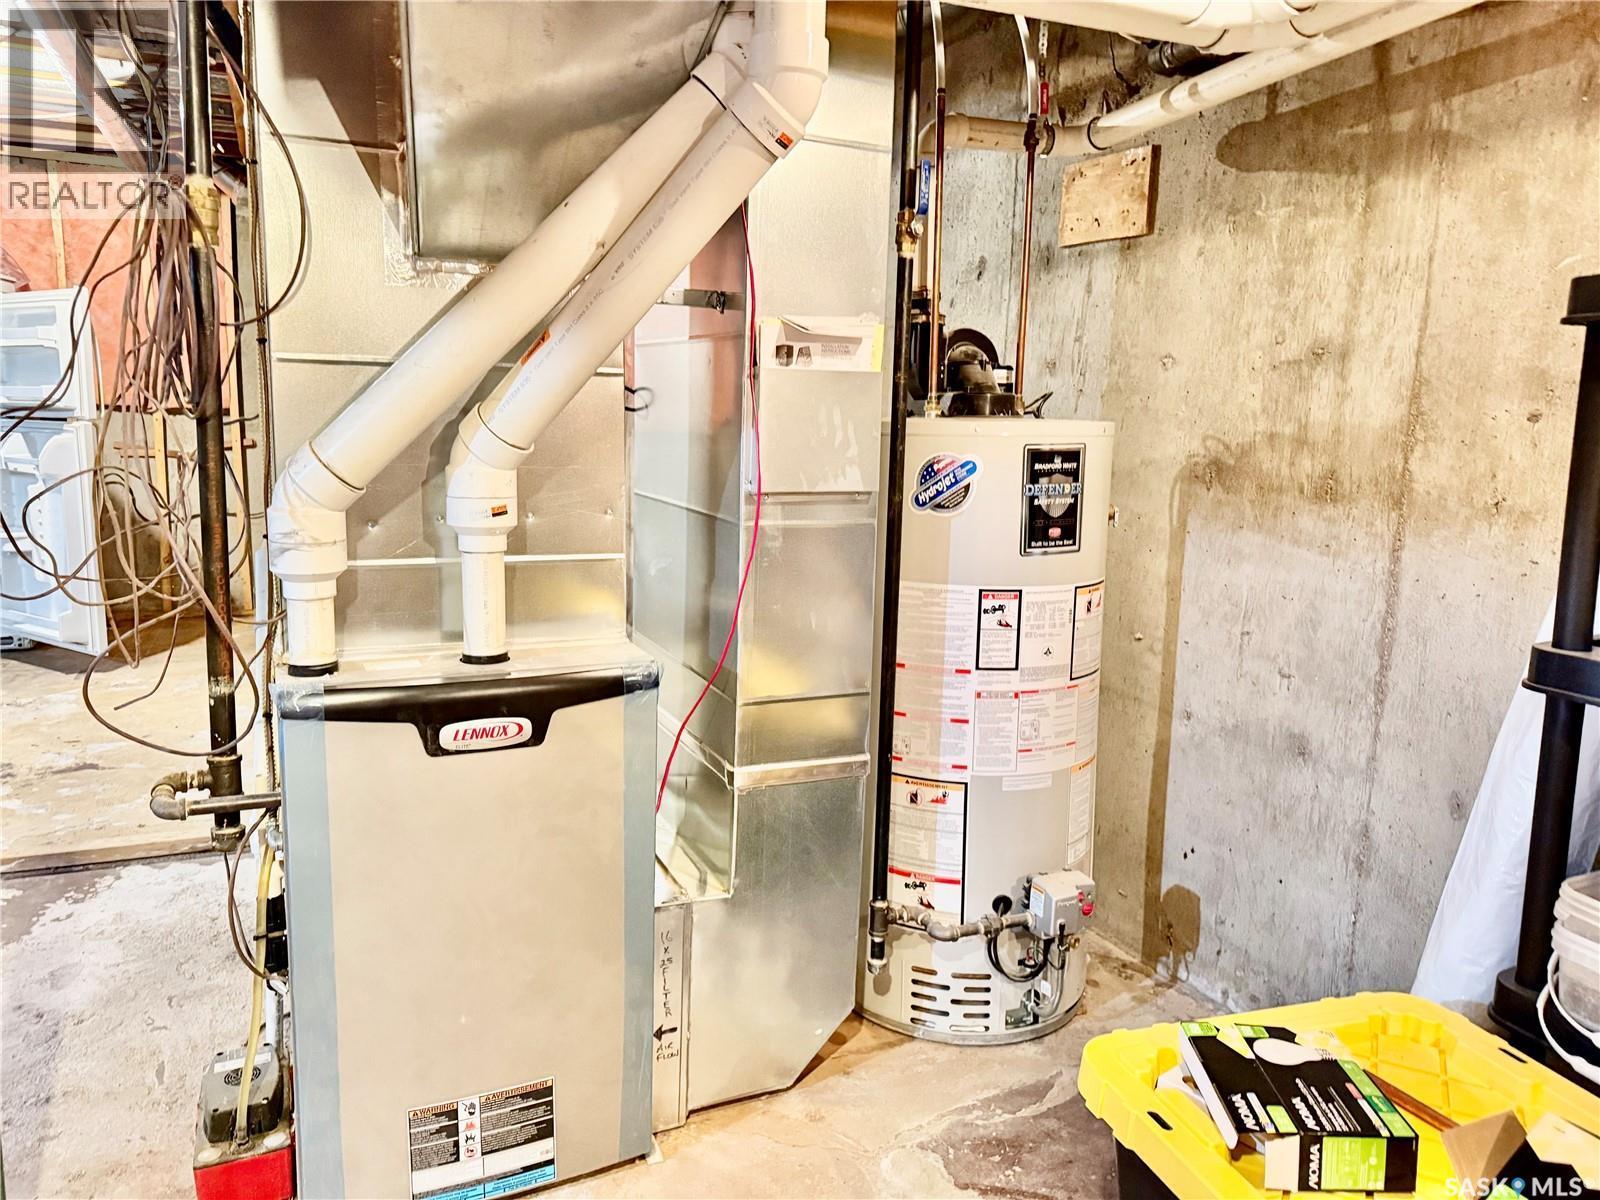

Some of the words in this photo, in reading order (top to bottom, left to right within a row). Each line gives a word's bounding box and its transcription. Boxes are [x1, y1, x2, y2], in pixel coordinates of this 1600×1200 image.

[1025, 483, 1082, 497] DEFENDER
[453, 724, 510, 742] LENNOX
[662, 967, 672, 1018] FILTER
[1308, 1143, 1321, 1190] NOMA
